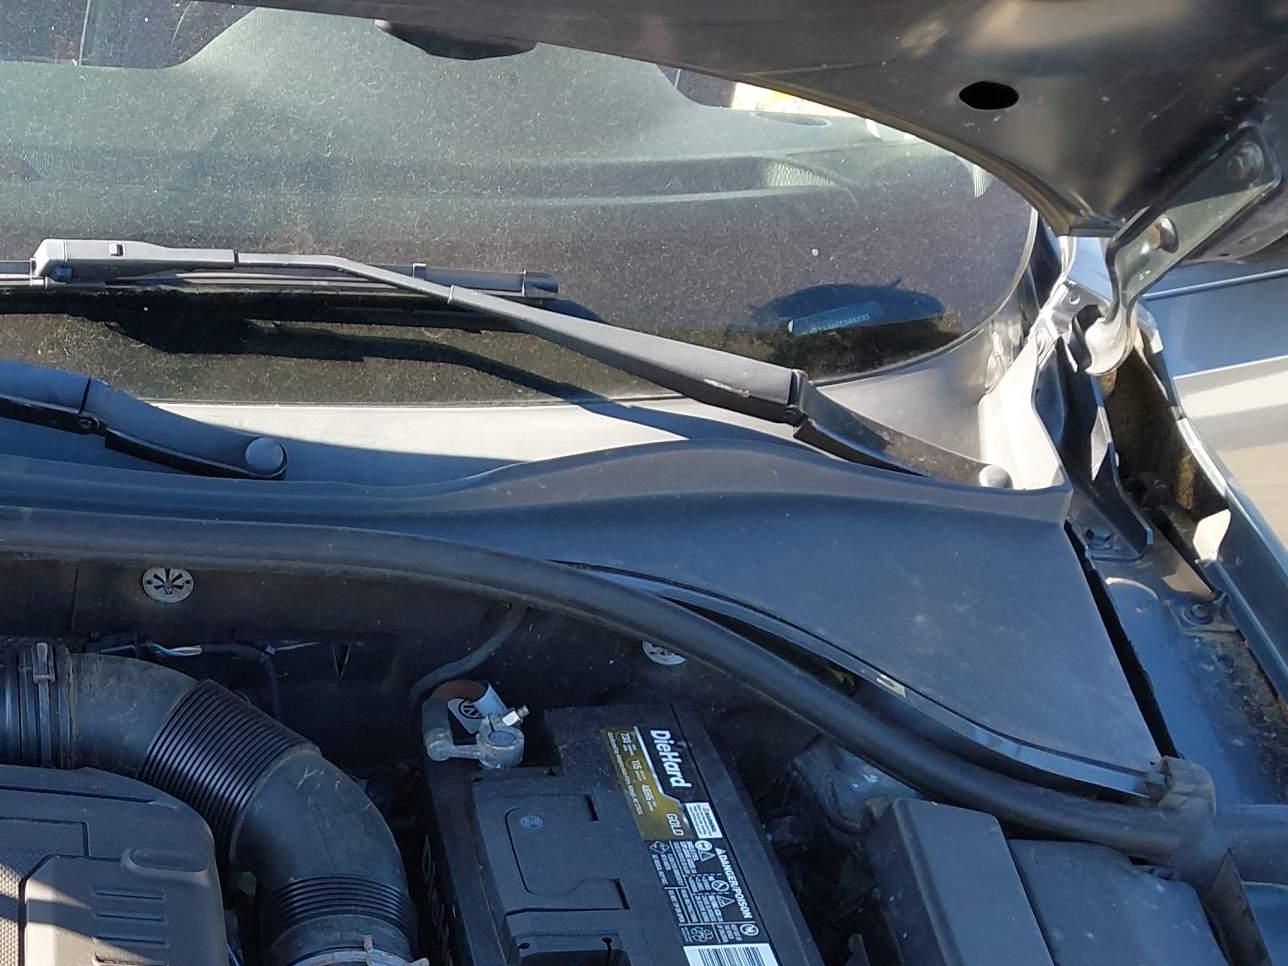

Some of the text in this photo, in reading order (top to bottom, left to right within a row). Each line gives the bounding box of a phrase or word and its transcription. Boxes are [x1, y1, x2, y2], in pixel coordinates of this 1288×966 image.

[649, 729, 693, 789] DieHard
[666, 813, 685, 837] GOLD
[717, 852, 754, 919] DANGER/POISON
